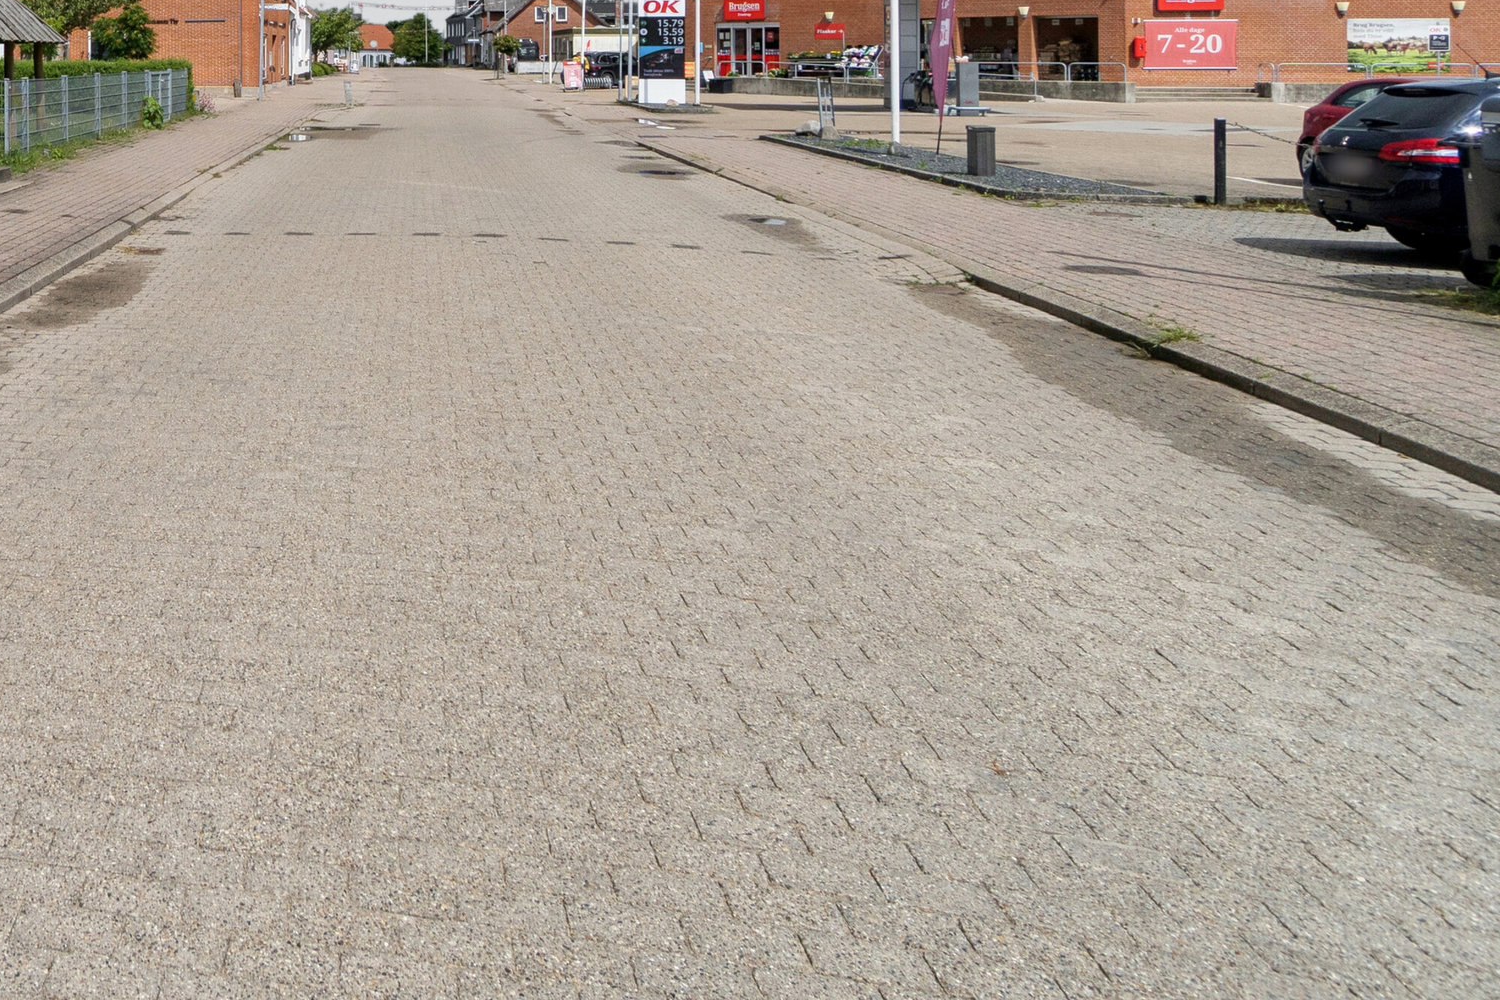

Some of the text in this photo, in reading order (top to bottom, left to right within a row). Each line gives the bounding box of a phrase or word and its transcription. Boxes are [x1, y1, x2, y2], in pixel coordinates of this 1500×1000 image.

[643, 0, 680, 13] OK
[729, 1, 760, 12] Brugsen
[658, 28, 684, 36] 15.59
[1157, 34, 1172, 53] 7
[1189, 34, 1223, 53] 20
